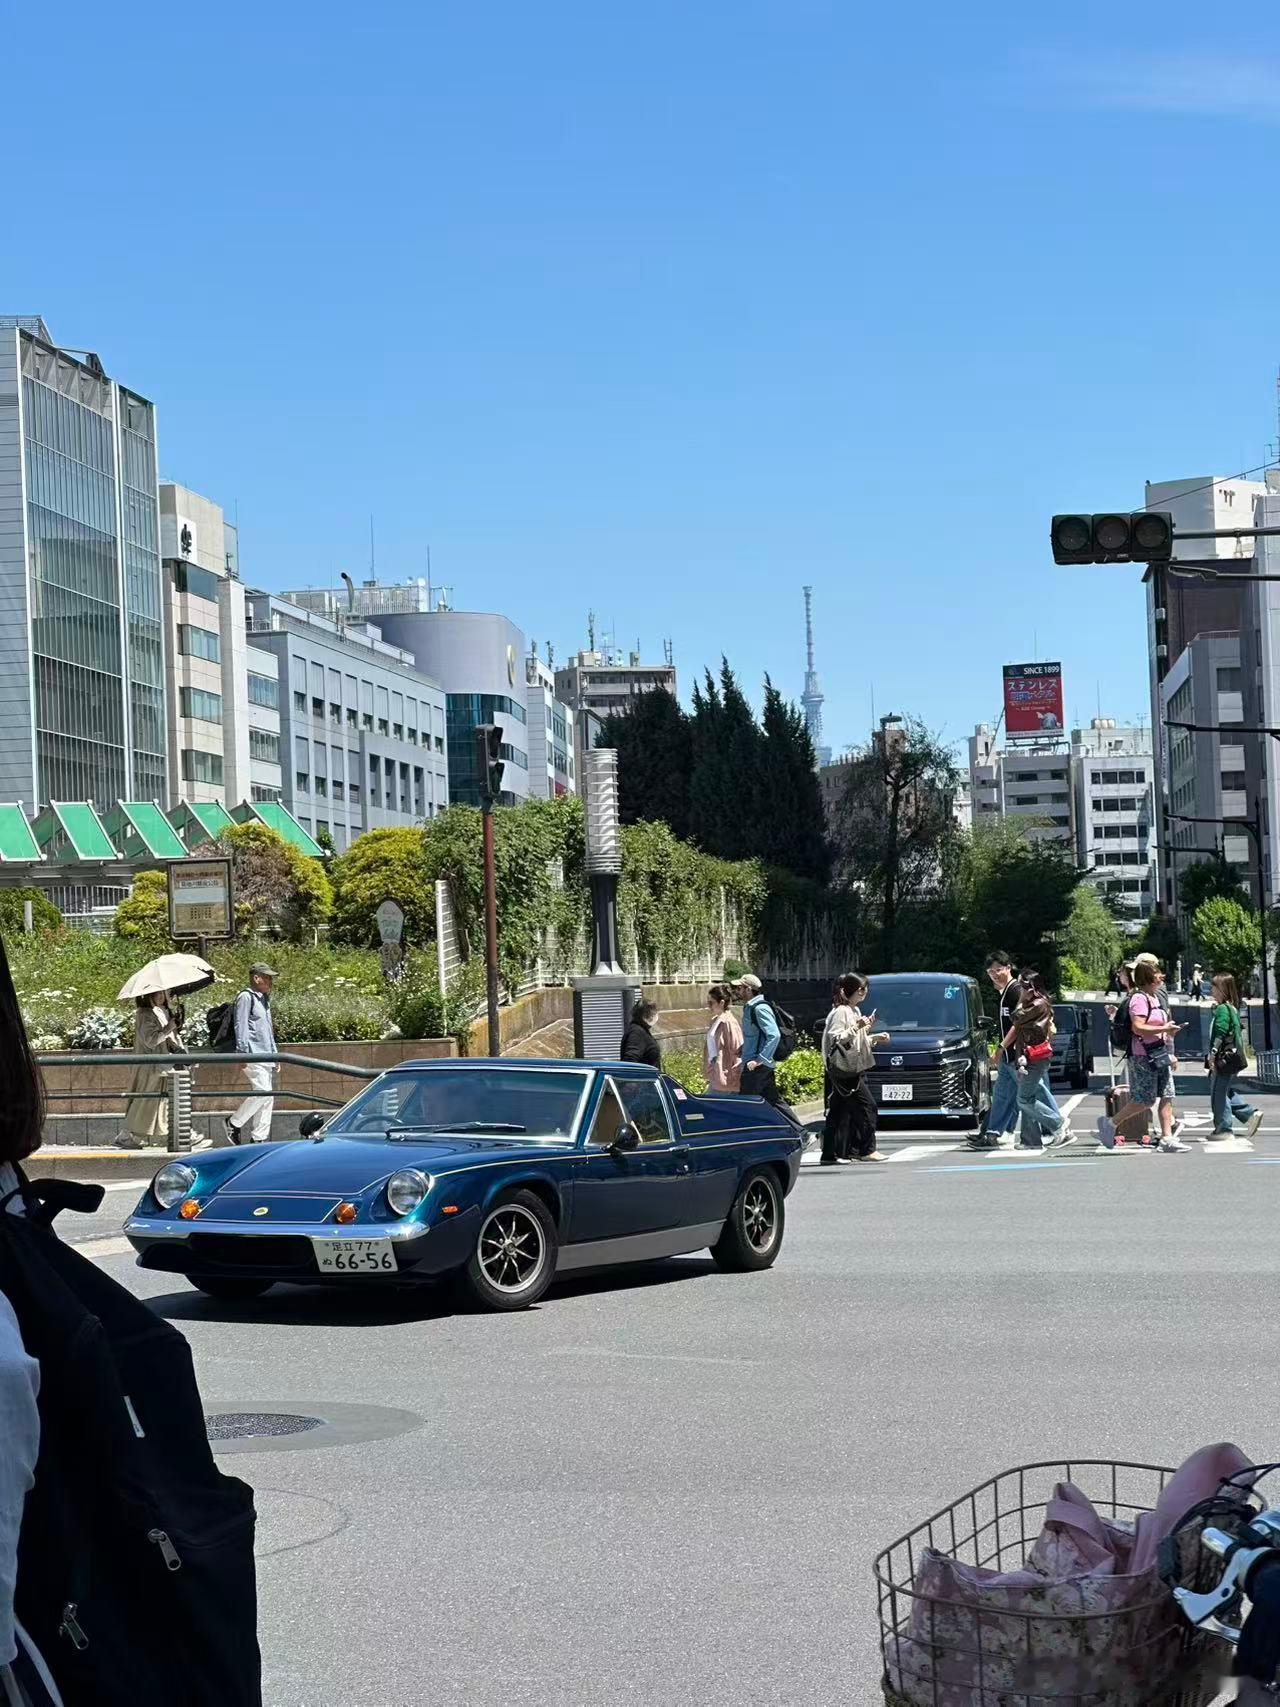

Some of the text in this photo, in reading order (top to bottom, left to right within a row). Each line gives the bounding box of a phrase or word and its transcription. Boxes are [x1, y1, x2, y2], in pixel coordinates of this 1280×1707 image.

[1023, 665, 1060, 675] SINCE 1899
[1008, 679, 1058, 691] ステンレス
[335, 1252, 392, 1270] 66-56
